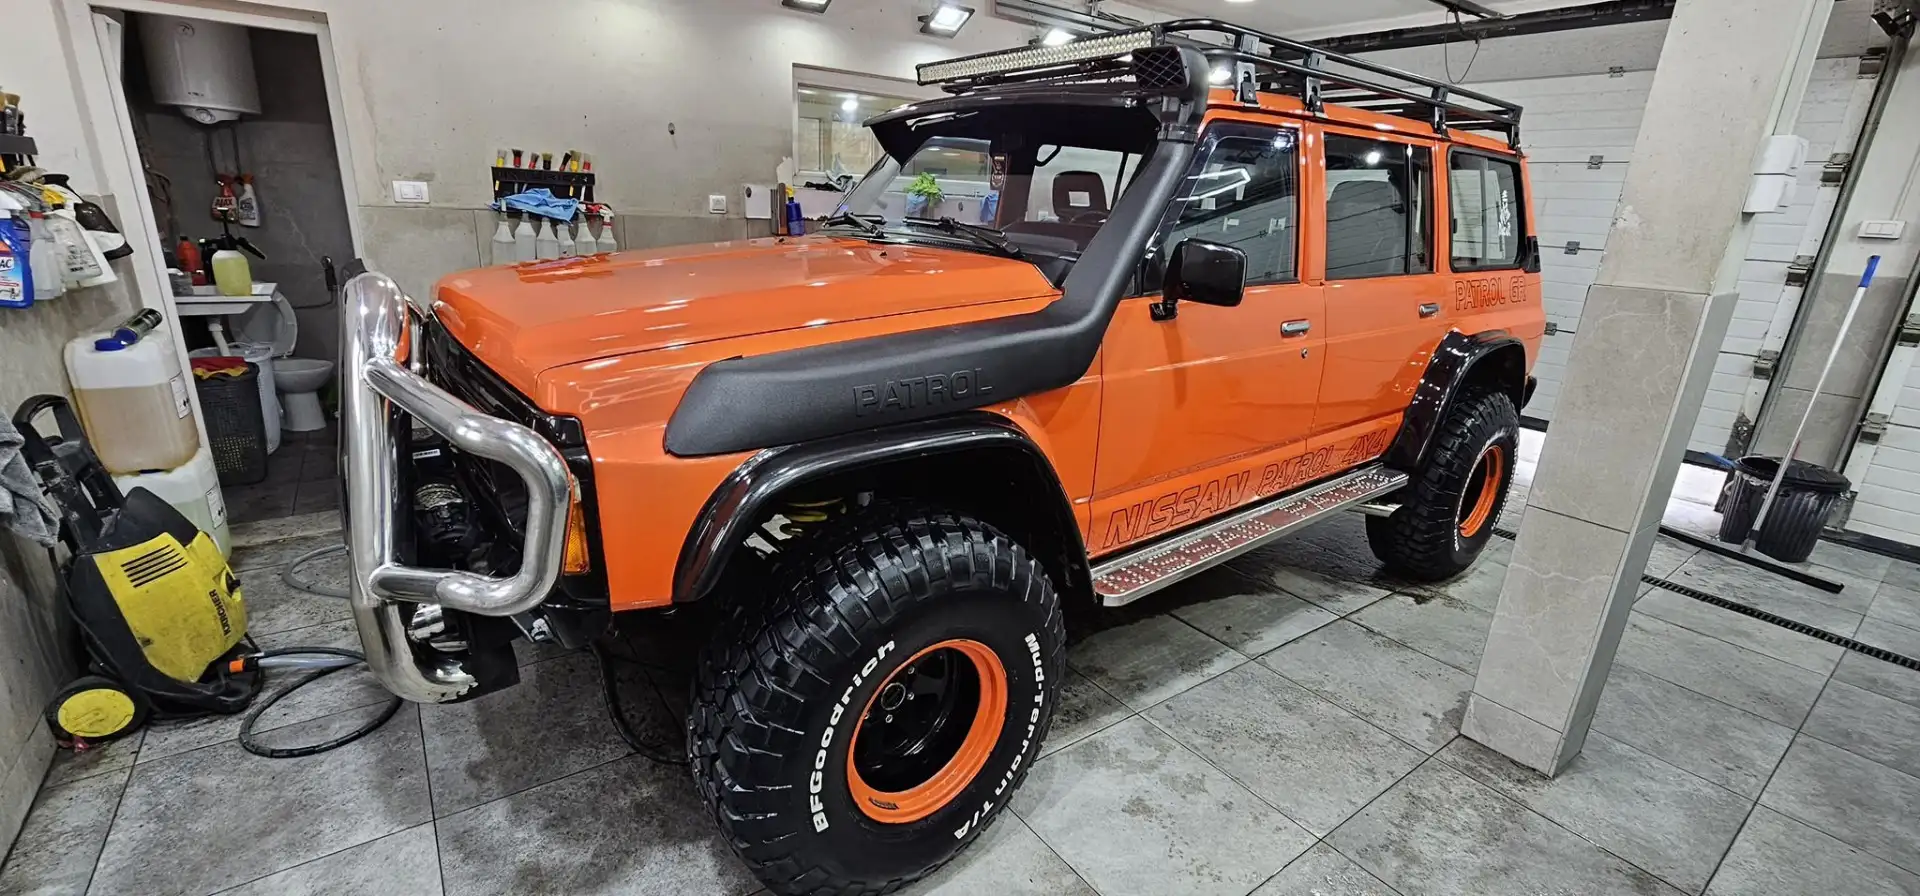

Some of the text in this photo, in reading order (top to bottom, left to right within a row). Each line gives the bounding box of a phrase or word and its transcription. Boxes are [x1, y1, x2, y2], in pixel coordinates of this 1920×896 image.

[214, 197, 234, 207] AJAX
[1455, 275, 1527, 311] PATROL GR
[853, 367, 993, 417] PATROL
[1102, 428, 1388, 549] NISSAN PATROL 4X4
[809, 639, 896, 833] BFGoodrich
[953, 632, 1045, 839] Mud-Terrain T/A
